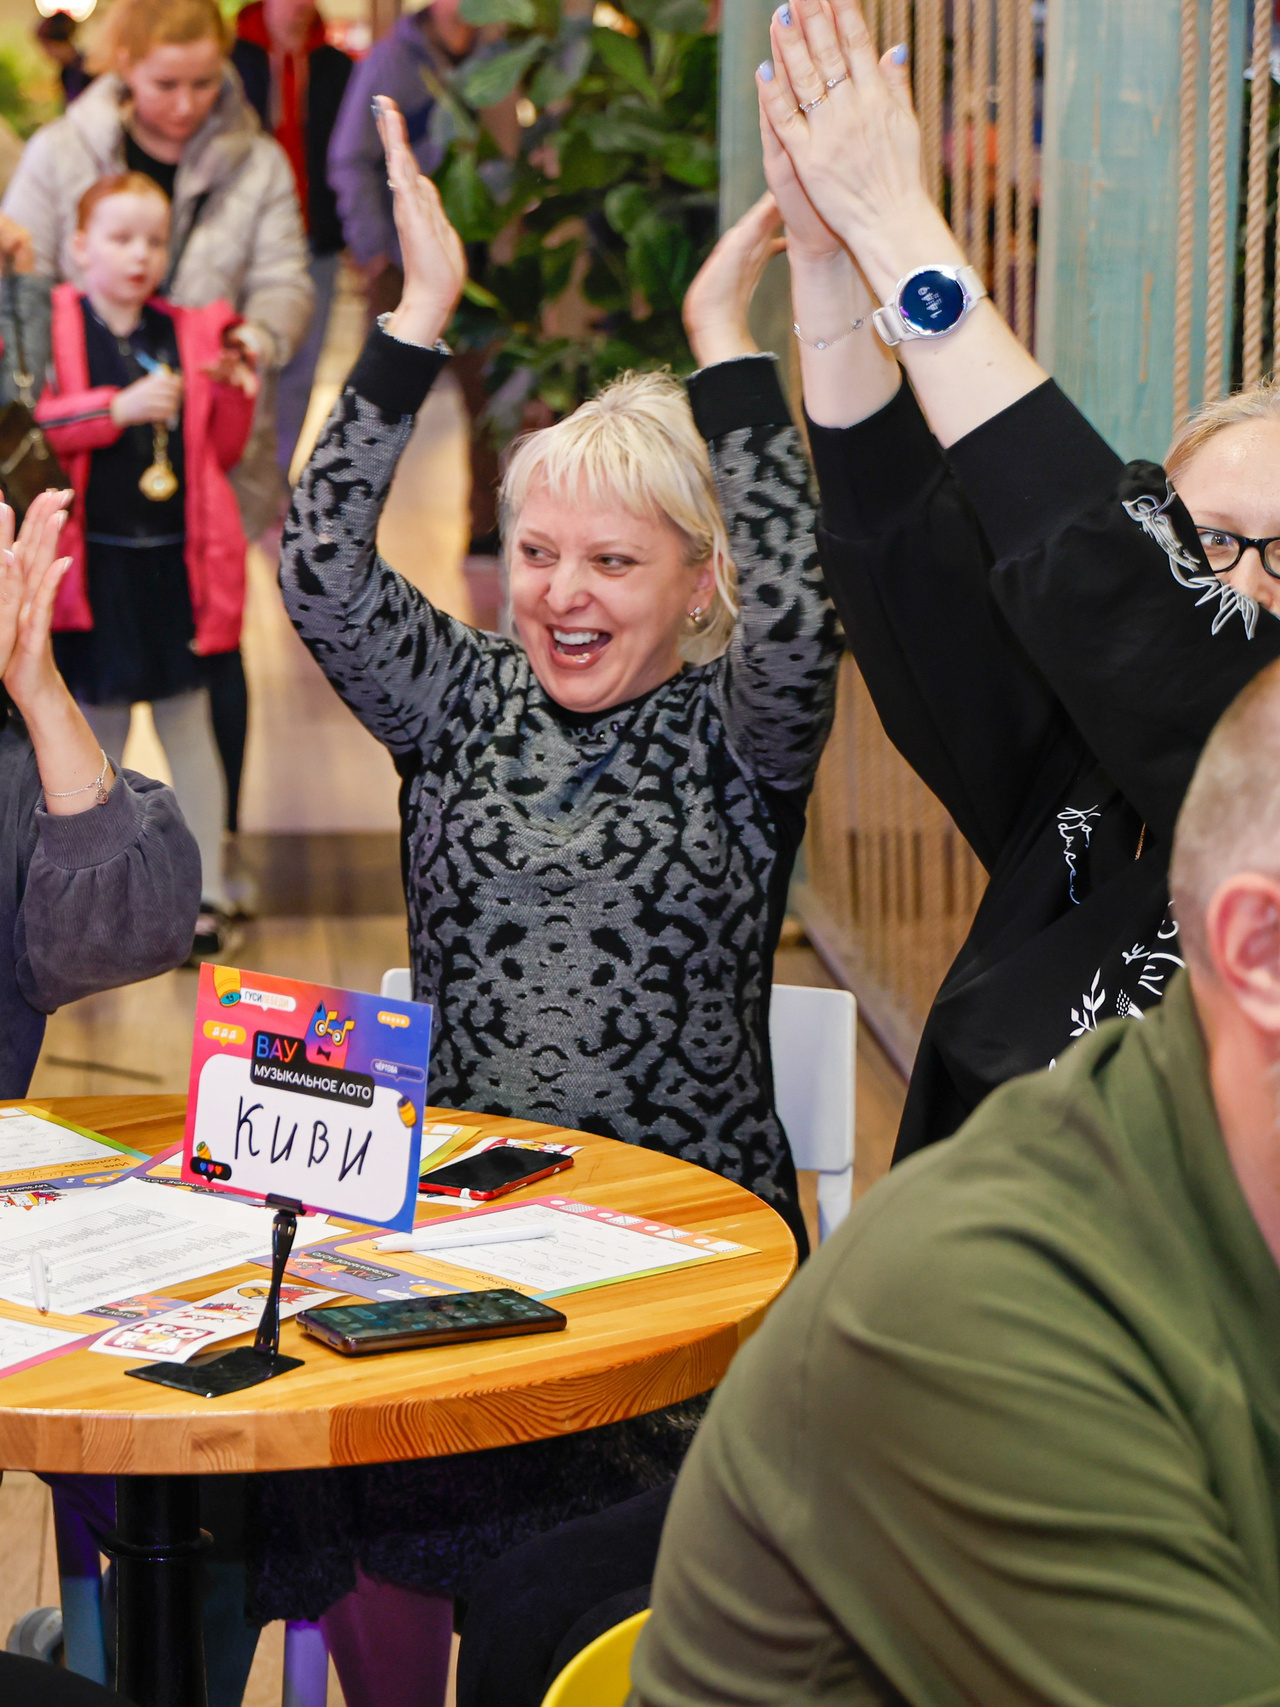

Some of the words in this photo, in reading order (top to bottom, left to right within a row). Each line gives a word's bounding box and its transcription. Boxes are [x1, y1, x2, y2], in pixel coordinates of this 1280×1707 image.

[256, 1034, 299, 1063] ВАУ
[254, 1063, 338, 1093] МУЗЫКАЛЬНОЕ
[339, 1081, 372, 1100] ЛОТО
